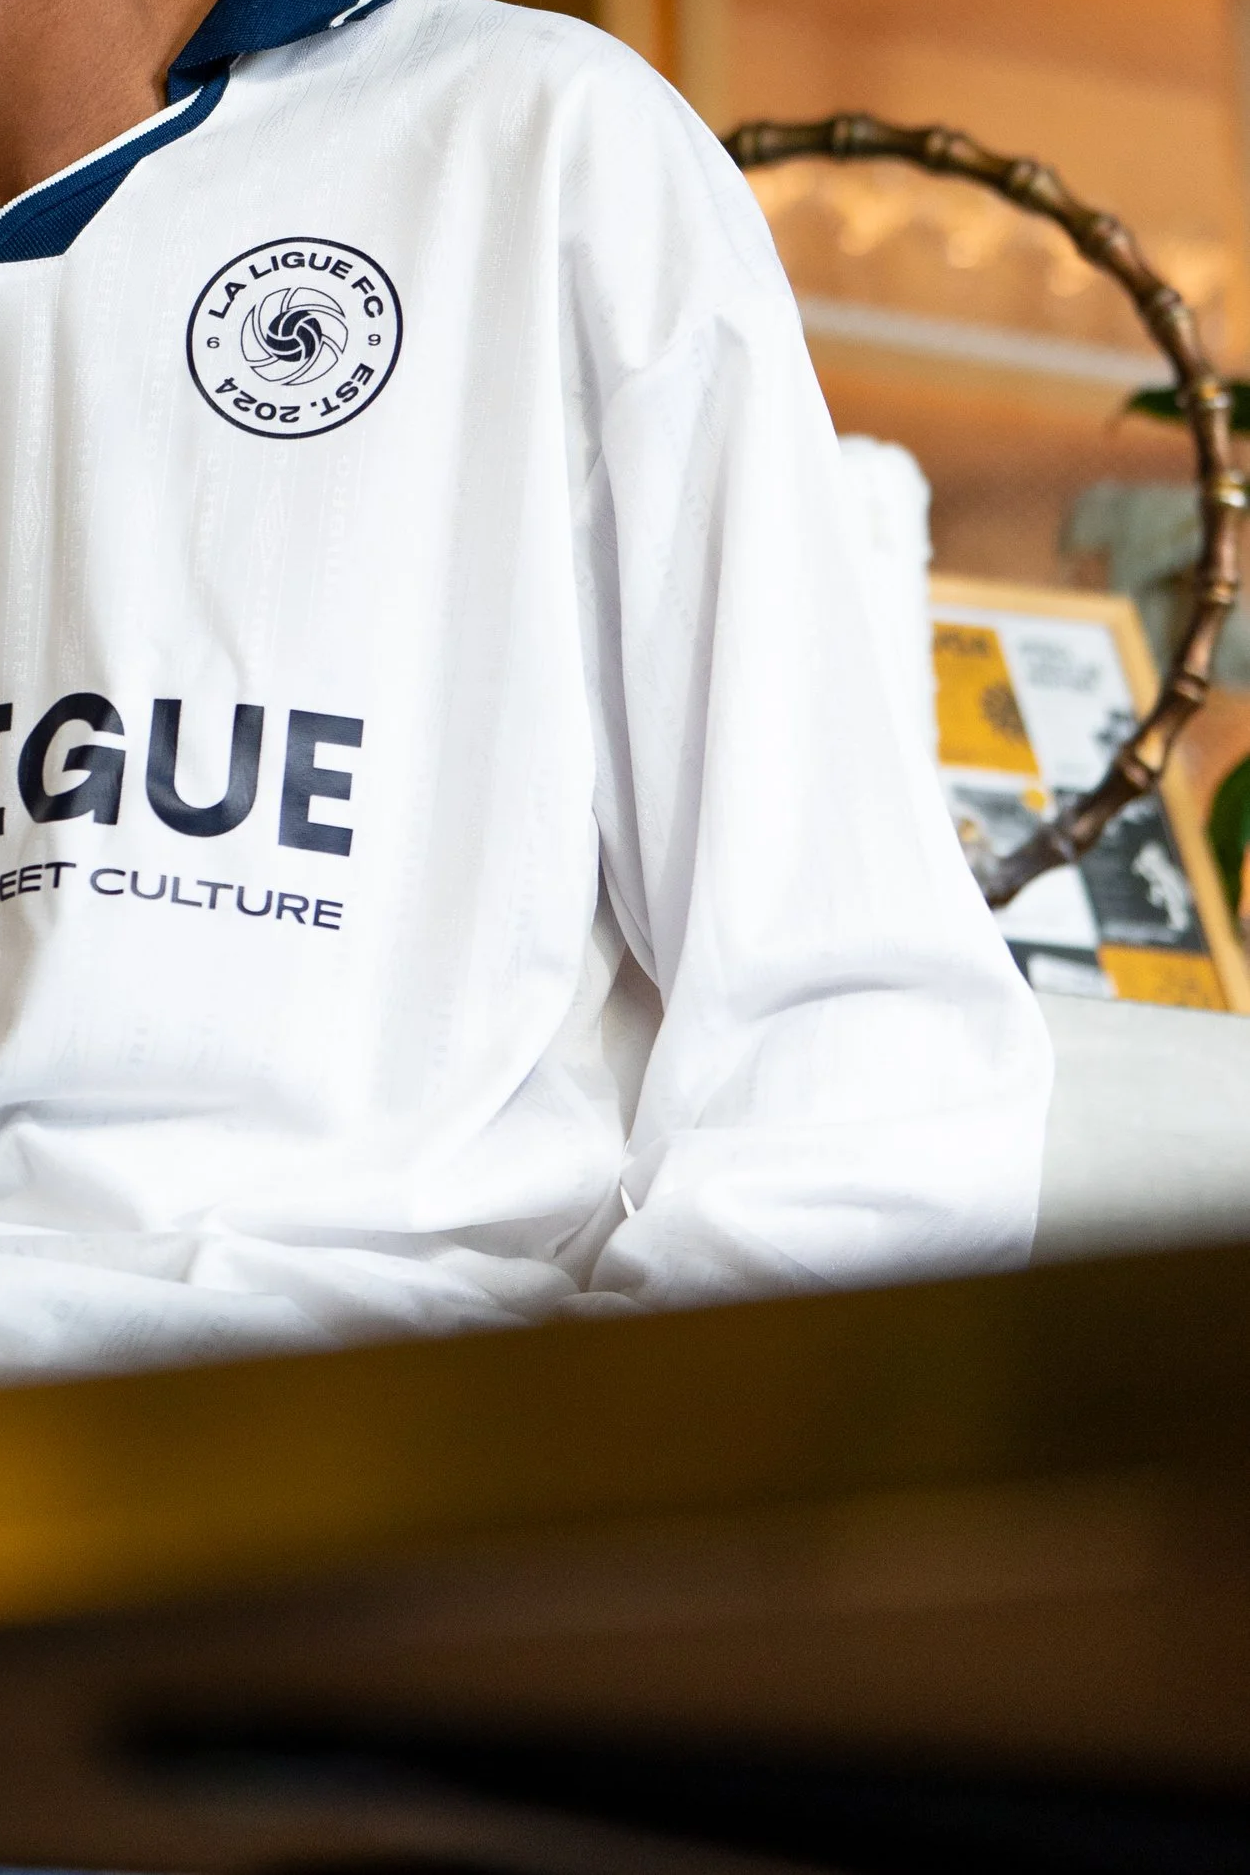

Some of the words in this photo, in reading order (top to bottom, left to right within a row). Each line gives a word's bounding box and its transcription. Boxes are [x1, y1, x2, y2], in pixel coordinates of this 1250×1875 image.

[208, 281, 248, 320] LA
[248, 251, 354, 281] LIGUE
[350, 275, 384, 319] FC
[206, 336, 220, 349] 6
[367, 333, 382, 347] 9
[214, 377, 301, 424] 2024
[310, 362, 375, 417] EST.
[89, 867, 345, 931] CULTURE
